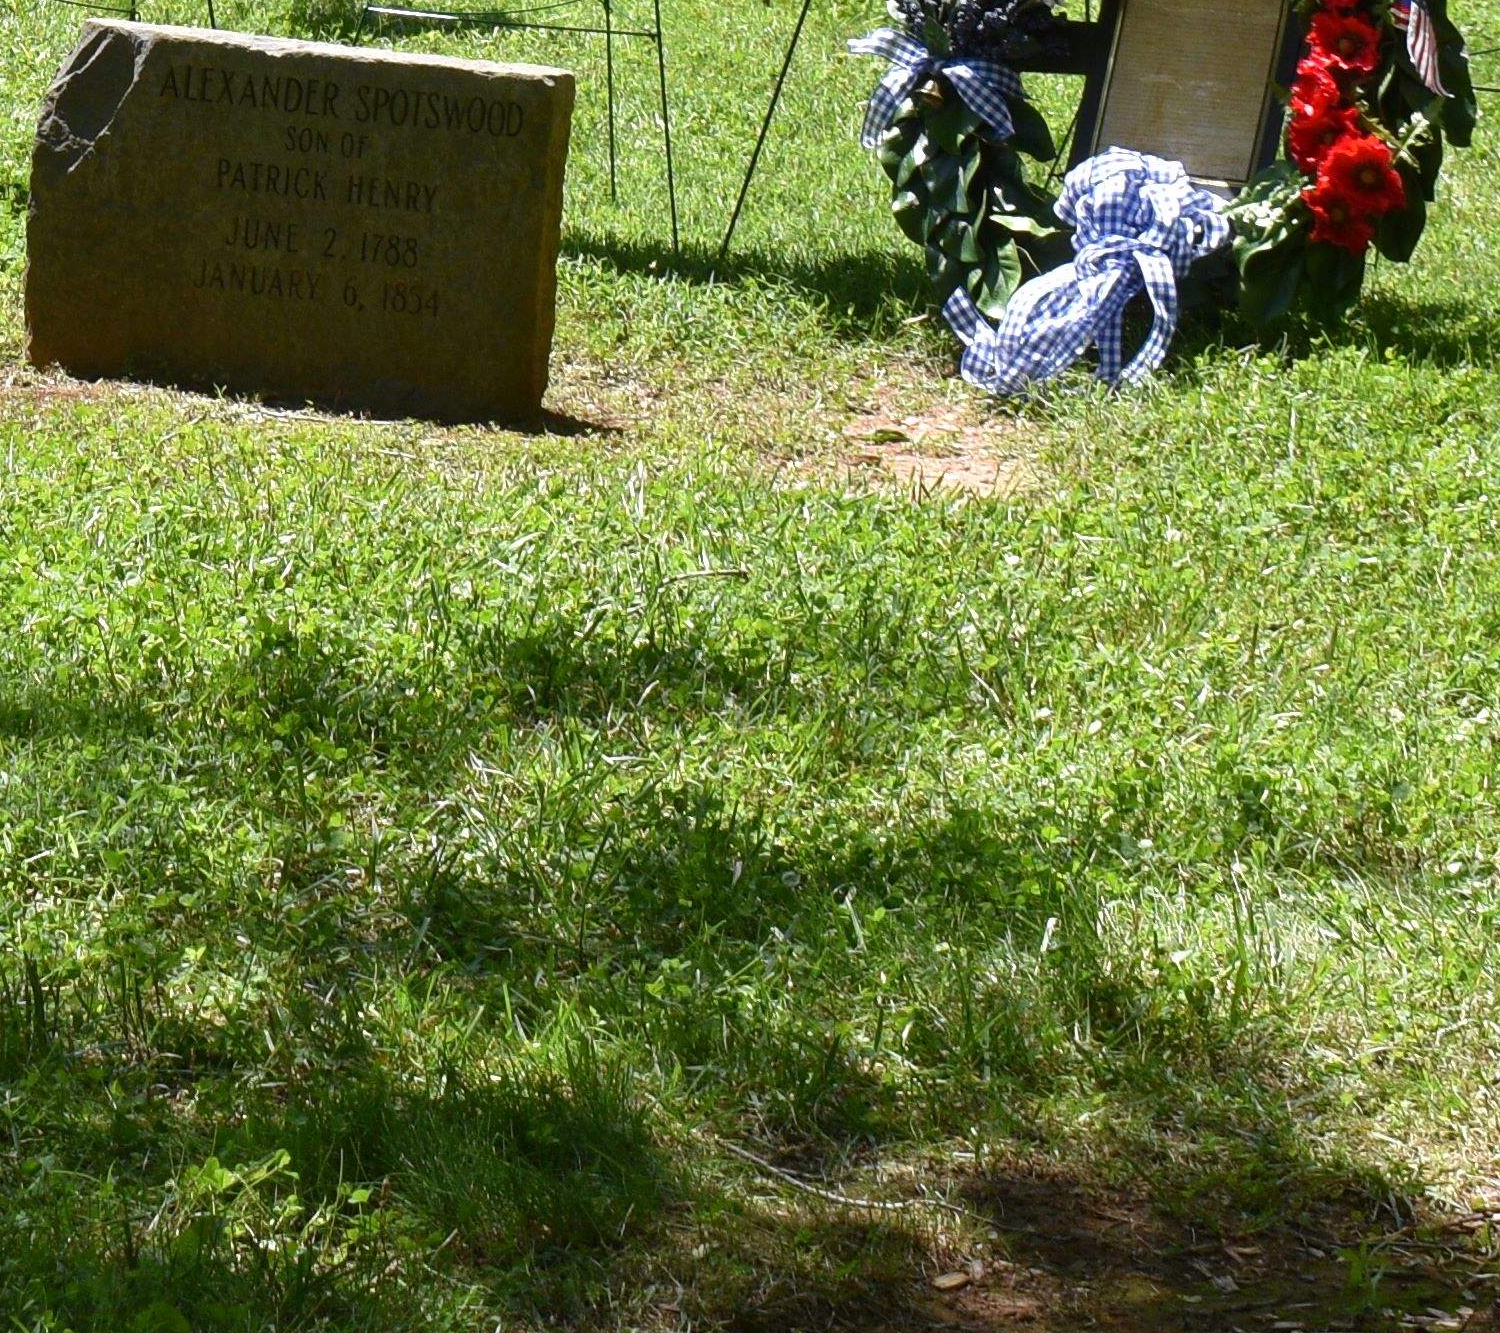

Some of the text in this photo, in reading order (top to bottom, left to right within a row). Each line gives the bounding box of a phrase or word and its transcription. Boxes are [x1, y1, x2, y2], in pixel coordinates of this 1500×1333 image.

[159, 64, 525, 138] ALEXANDER SPOTSWOOD
[285, 125, 370, 160] SON OF
[217, 158, 439, 214] PATRICK HENRY
[225, 217, 300, 254] JUNE
[360, 232, 419, 269] 1788
[193, 258, 440, 318] JANUARY 6, 1854
